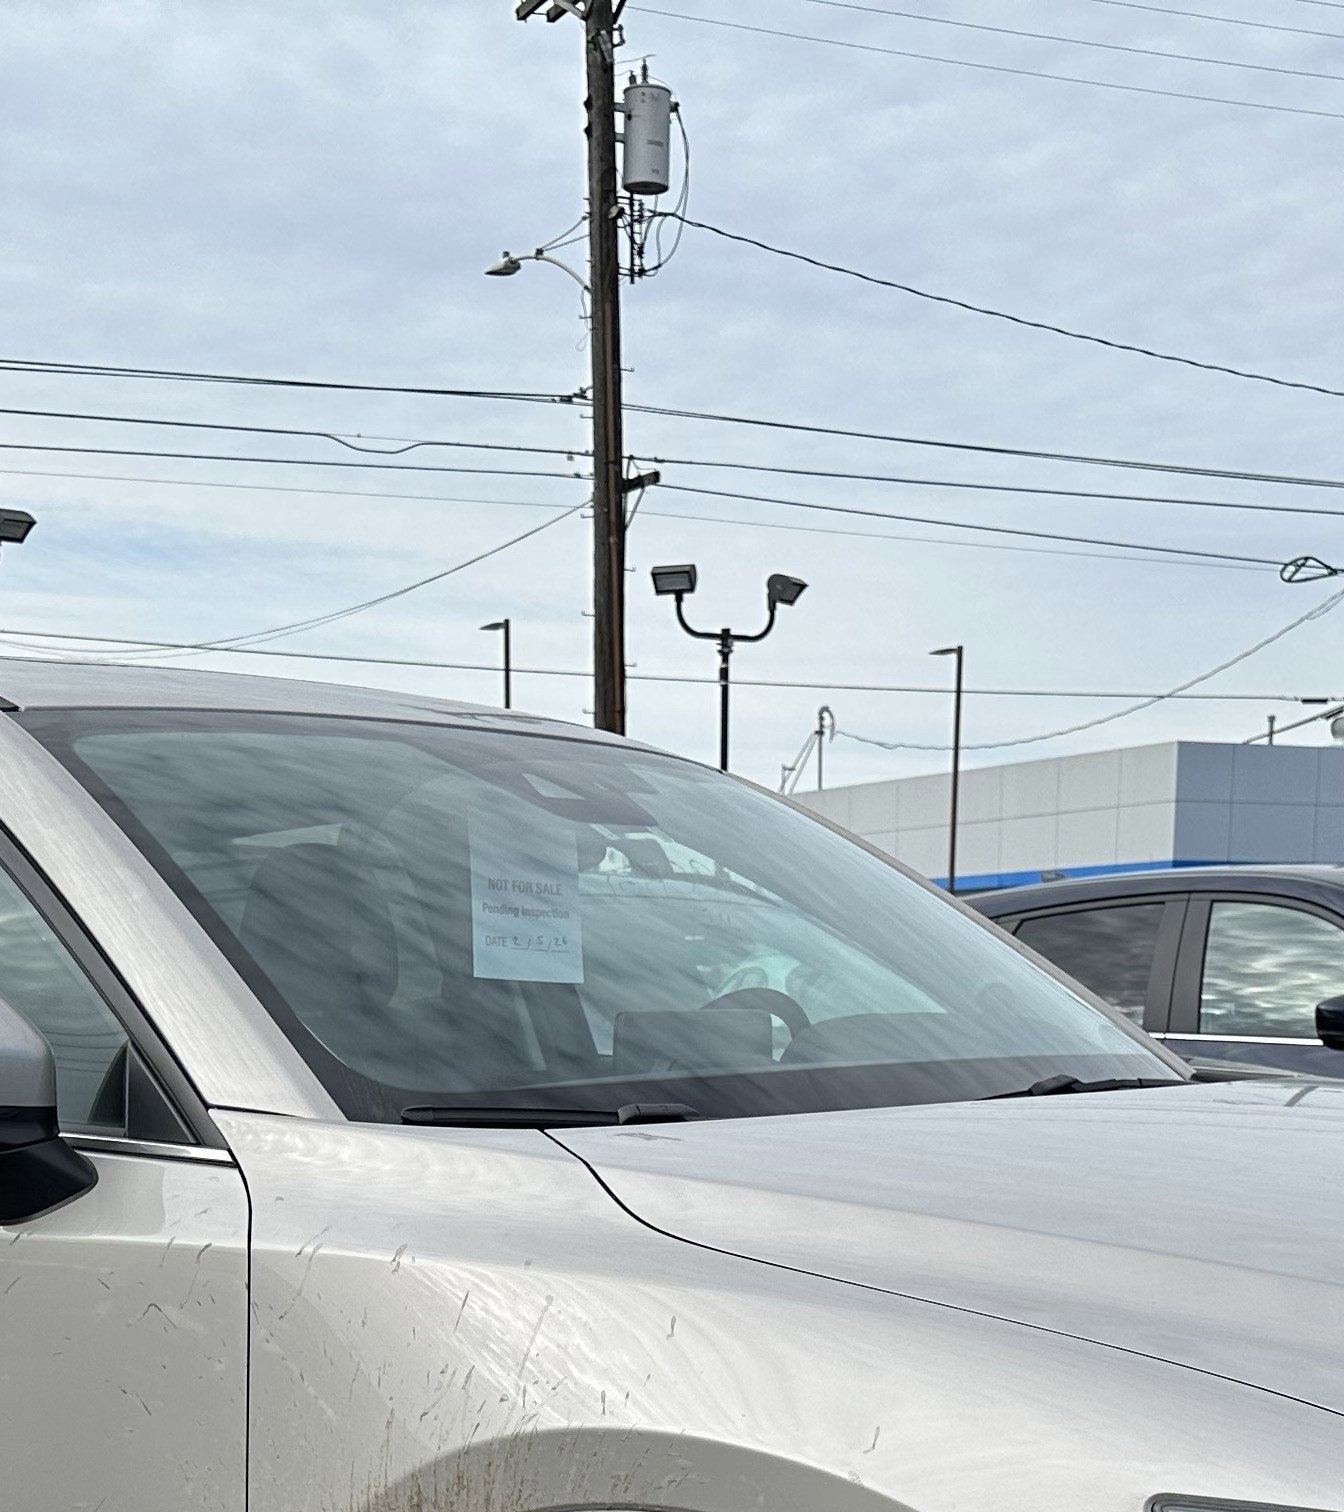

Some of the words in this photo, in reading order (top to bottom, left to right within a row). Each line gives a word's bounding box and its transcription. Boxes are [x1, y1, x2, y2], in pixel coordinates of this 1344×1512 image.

[488, 878, 509, 892] NOT
[512, 880, 534, 894] FOR
[536, 882, 562, 896] SALE
[482, 902, 520, 918] Pending
[521, 906, 570, 920] Inspection
[485, 935, 508, 948] DATE
